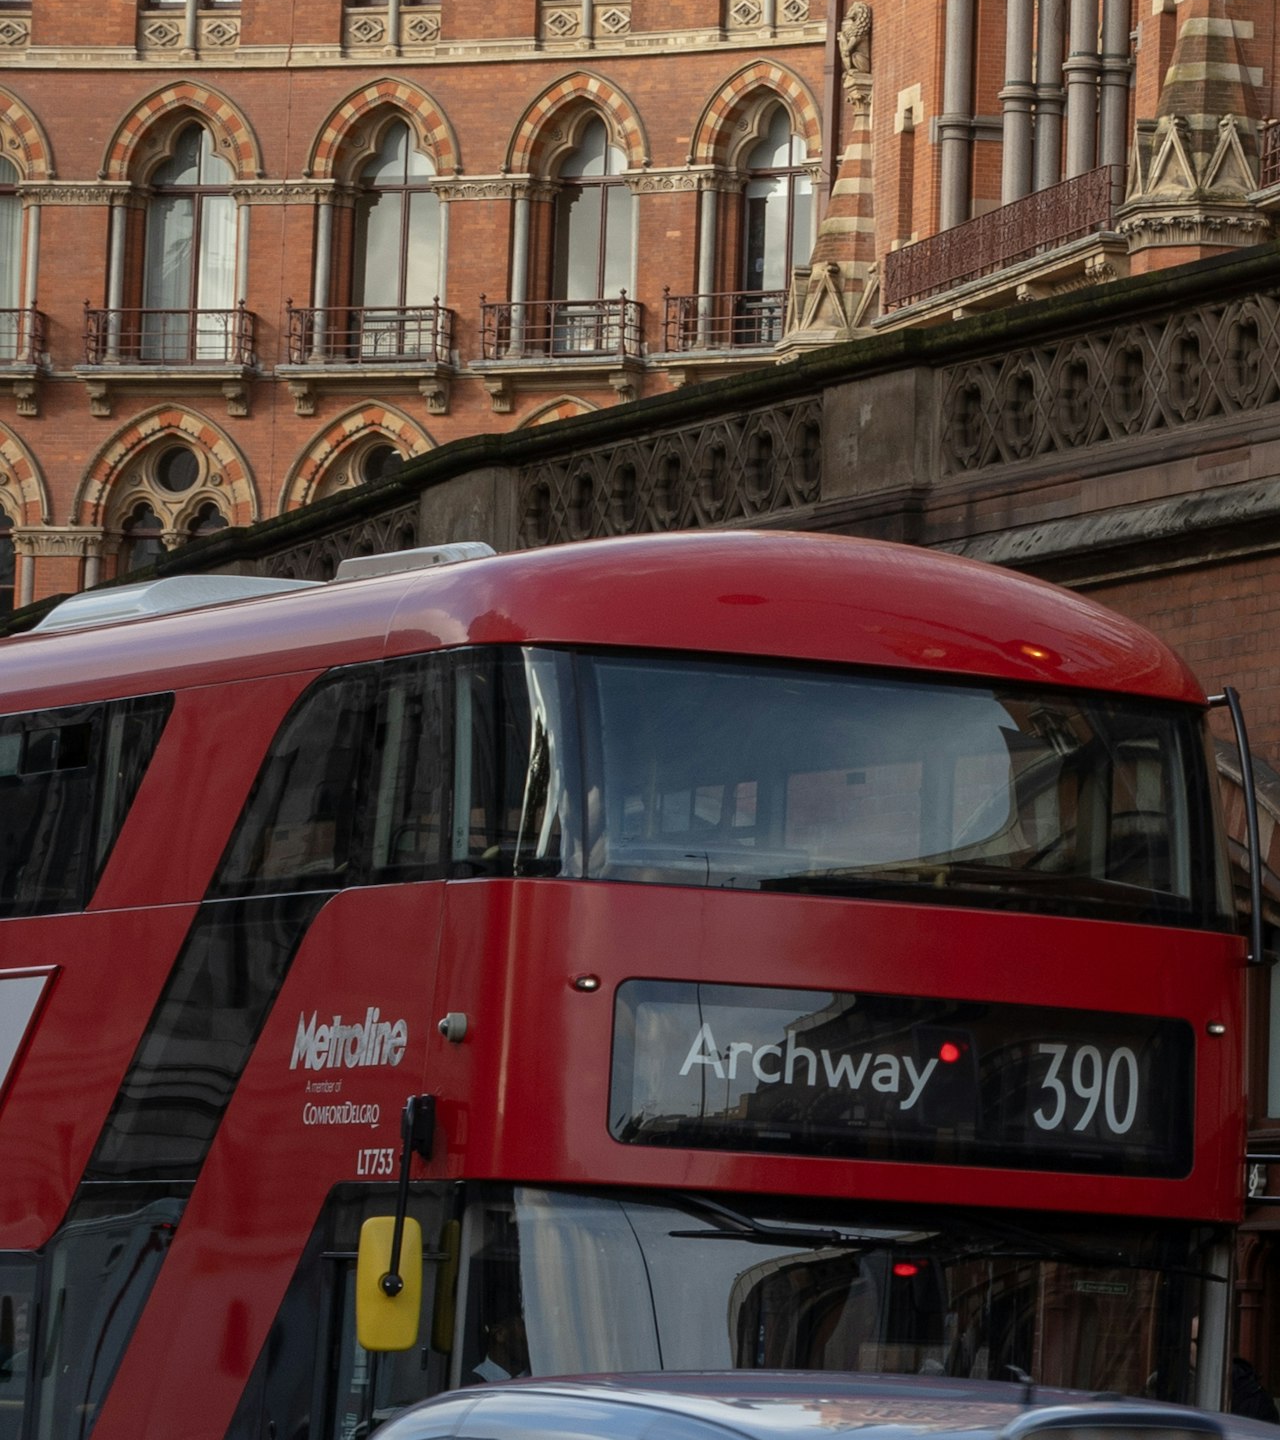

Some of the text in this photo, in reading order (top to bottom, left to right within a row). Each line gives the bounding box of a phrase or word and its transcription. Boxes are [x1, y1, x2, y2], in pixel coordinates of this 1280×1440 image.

[288, 1006, 409, 1072] Metroline
[305, 1078, 342, 1093] A member of
[678, 1022, 1141, 1135] Archway 390
[356, 1148, 394, 1176] LT753
